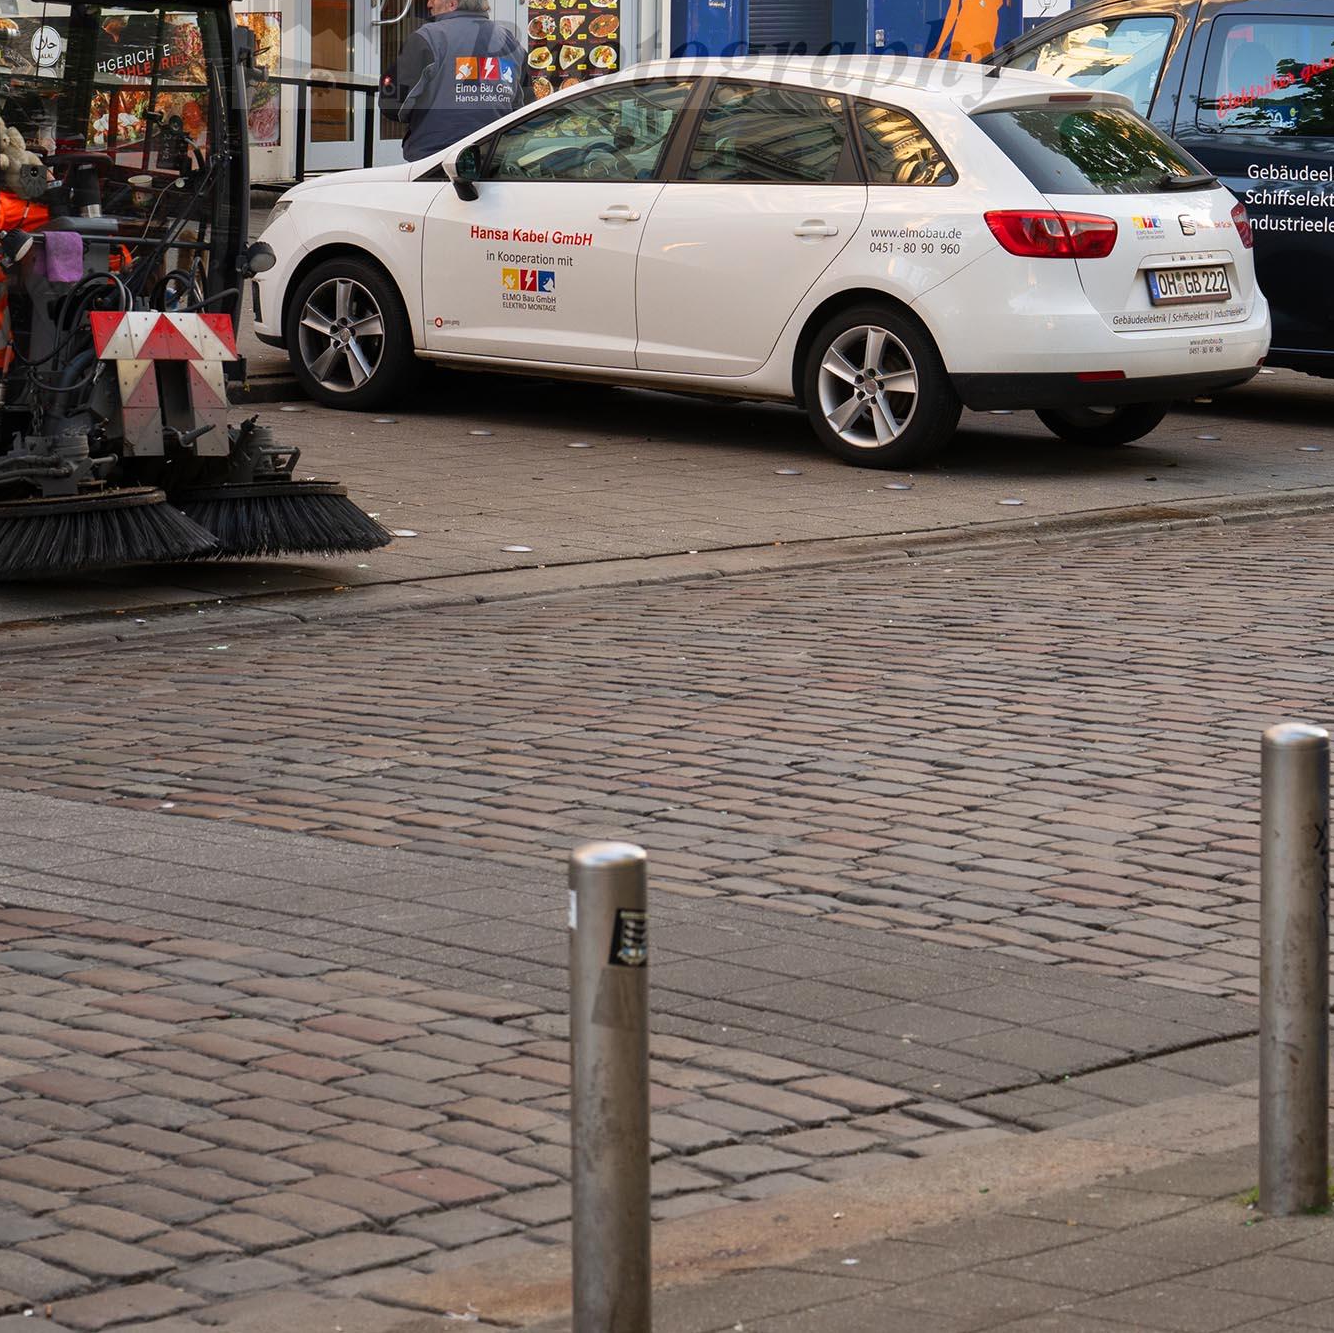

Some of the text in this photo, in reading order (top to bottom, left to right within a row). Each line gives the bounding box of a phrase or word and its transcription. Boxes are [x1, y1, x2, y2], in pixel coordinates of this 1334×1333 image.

[455, 83, 478, 93] Elmo
[470, 225, 593, 246] Hansa Kabel GmbH
[871, 228, 962, 239] www.elmobau.de
[870, 242, 893, 253] 0451
[903, 242, 917, 254] 80
[921, 242, 935, 254] 90
[940, 243, 961, 255] 960
[487, 249, 574, 267] in Kooperation mit
[1159, 269, 1228, 296] OH GB 222
[502, 292, 557, 304] ELMO Bau GmbH
[502, 301, 557, 313] ELEKTRO MONTAGE
